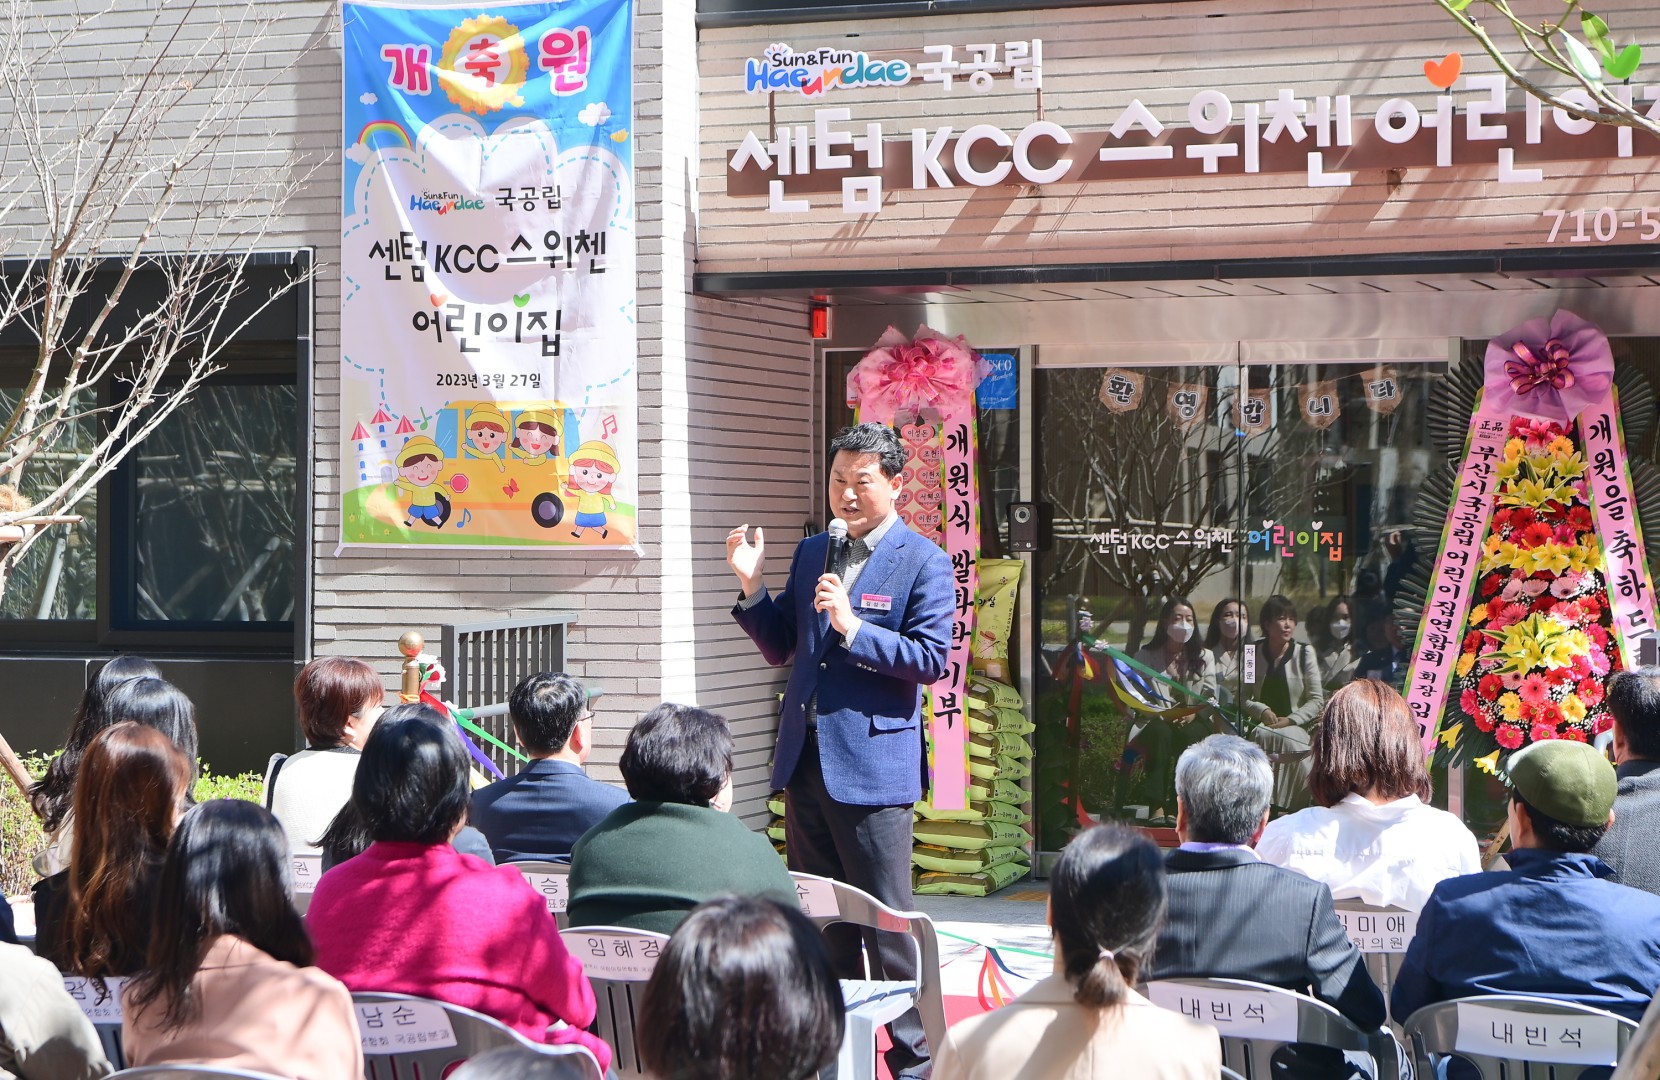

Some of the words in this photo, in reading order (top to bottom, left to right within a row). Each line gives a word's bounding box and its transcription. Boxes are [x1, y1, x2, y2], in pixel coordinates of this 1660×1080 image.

[383, 46, 429, 92] 개
[464, 38, 501, 88] 축
[541, 30, 588, 92] 원
[746, 54, 908, 95] Haeundae
[772, 50, 853, 68] Sun&Fun
[917, 39, 1043, 92] 국공립
[729, 108, 883, 213] 센텀
[912, 121, 1073, 190] KCC
[1100, 89, 1353, 187] 스위첸
[410, 194, 485, 215] Haeundae
[423, 191, 459, 200] Sun&Fun
[495, 185, 562, 211] 국공립
[1542, 206, 1660, 243] 710-5
[368, 231, 428, 282] 센텀
[434, 244, 500, 273] KCC
[506, 229, 606, 274] 스위첸
[412, 304, 562, 356] 어린이집
[436, 373, 478, 388] 2023년
[482, 373, 505, 389] 3월
[509, 373, 541, 388] 27일
[1479, 420, 1503, 431] 正品
[947, 424, 970, 535] 개원식
[1589, 414, 1628, 521] 개원을
[1090, 528, 1128, 555] 센텀
[1131, 533, 1170, 550] KCC
[1173, 528, 1232, 553] 스위첸
[1248, 525, 1343, 562] 어린이집
[588, 938, 661, 958] 임혜경
[1180, 997, 1265, 1023] 내빈석
[1492, 1021, 1582, 1048] 내빈석
